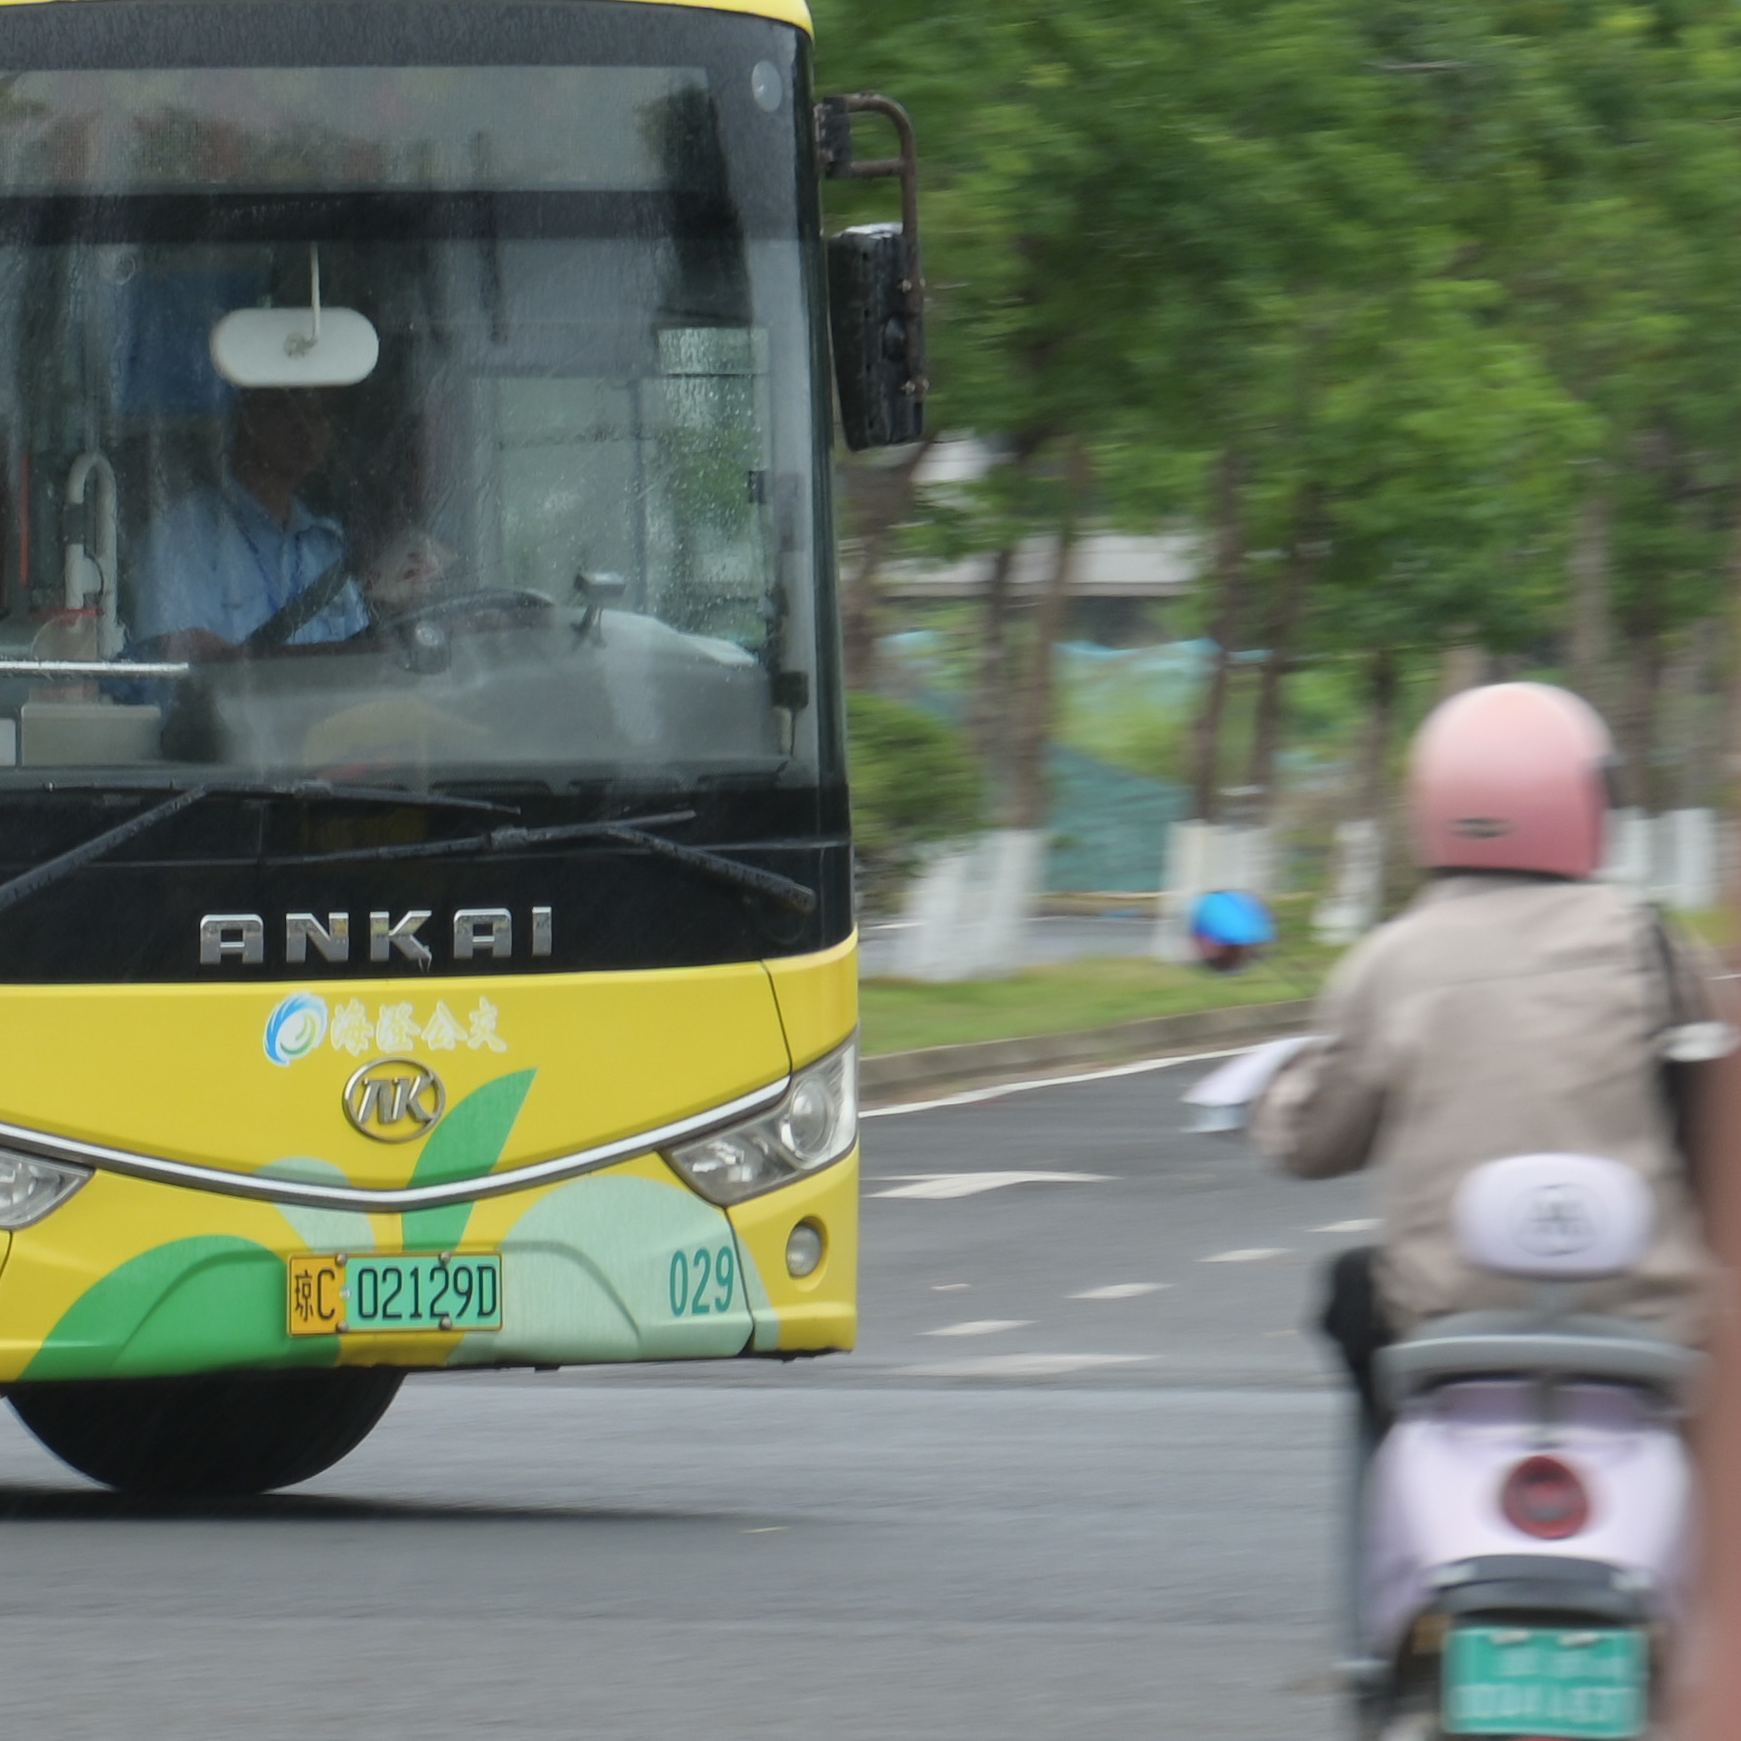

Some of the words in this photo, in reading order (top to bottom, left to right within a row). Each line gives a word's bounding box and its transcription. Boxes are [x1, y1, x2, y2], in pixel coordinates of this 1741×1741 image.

[200, 906, 552, 965] ANKAI
[330, 996, 508, 1056] 海澄公交
[669, 1245, 733, 1317] 029
